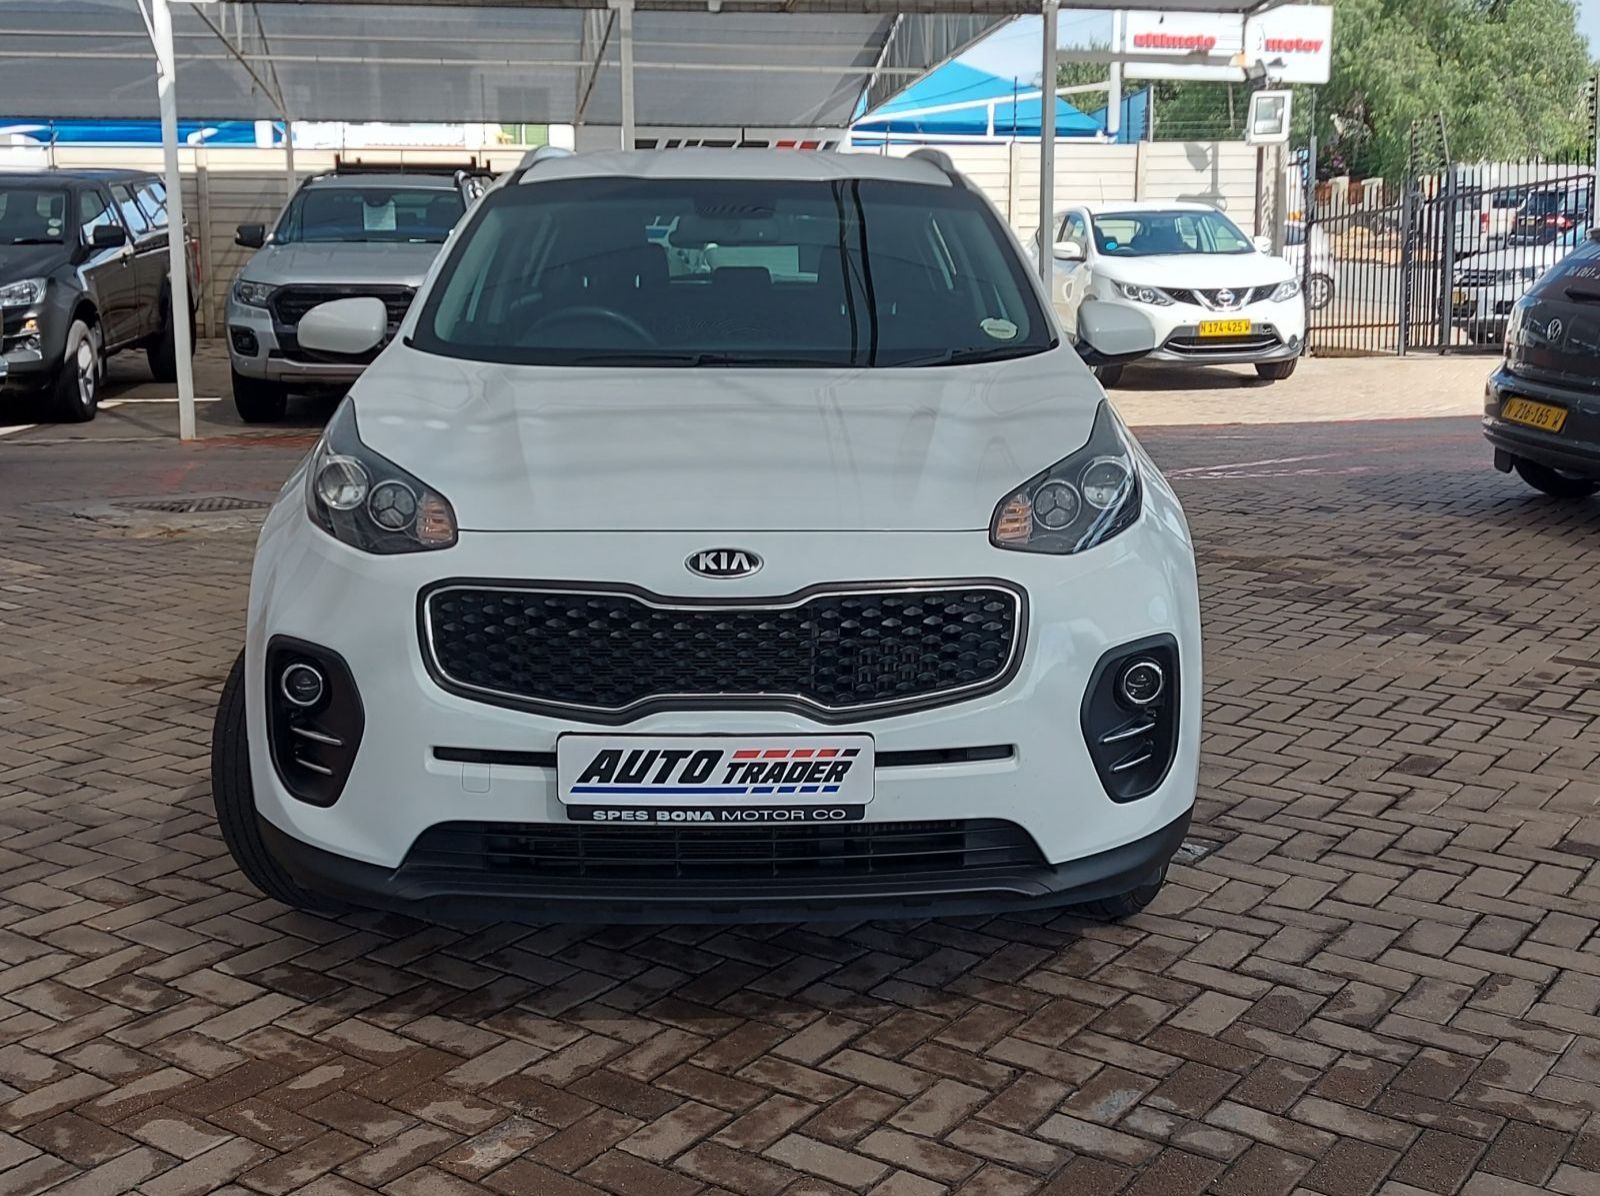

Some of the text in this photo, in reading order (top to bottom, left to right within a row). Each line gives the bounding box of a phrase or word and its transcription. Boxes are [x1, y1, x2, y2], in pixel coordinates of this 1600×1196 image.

[1264, 36, 1324, 53] motor
[699, 552, 751, 570] KIA
[576, 749, 853, 784] AUTO TRADER
[593, 809, 846, 821] SPES BONA MOTOR CO
